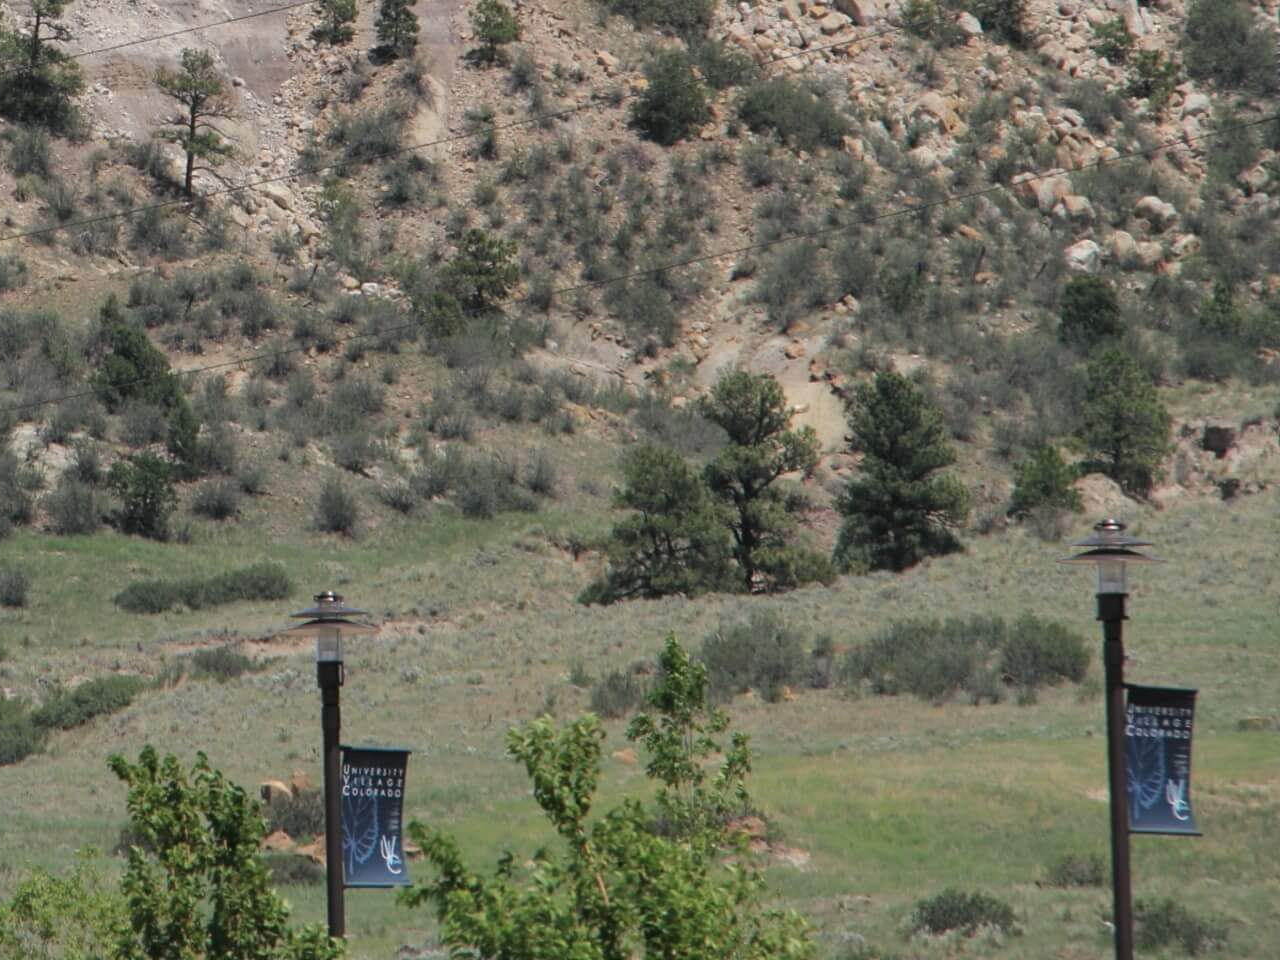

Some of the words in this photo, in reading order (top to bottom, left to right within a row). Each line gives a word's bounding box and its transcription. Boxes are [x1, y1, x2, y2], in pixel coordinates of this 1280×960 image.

[1125, 724, 1189, 739] COLORADO
[343, 764, 403, 776] UNIVERSITY
[343, 775, 402, 787] VILLAGE
[342, 785, 401, 798] COLORADO
